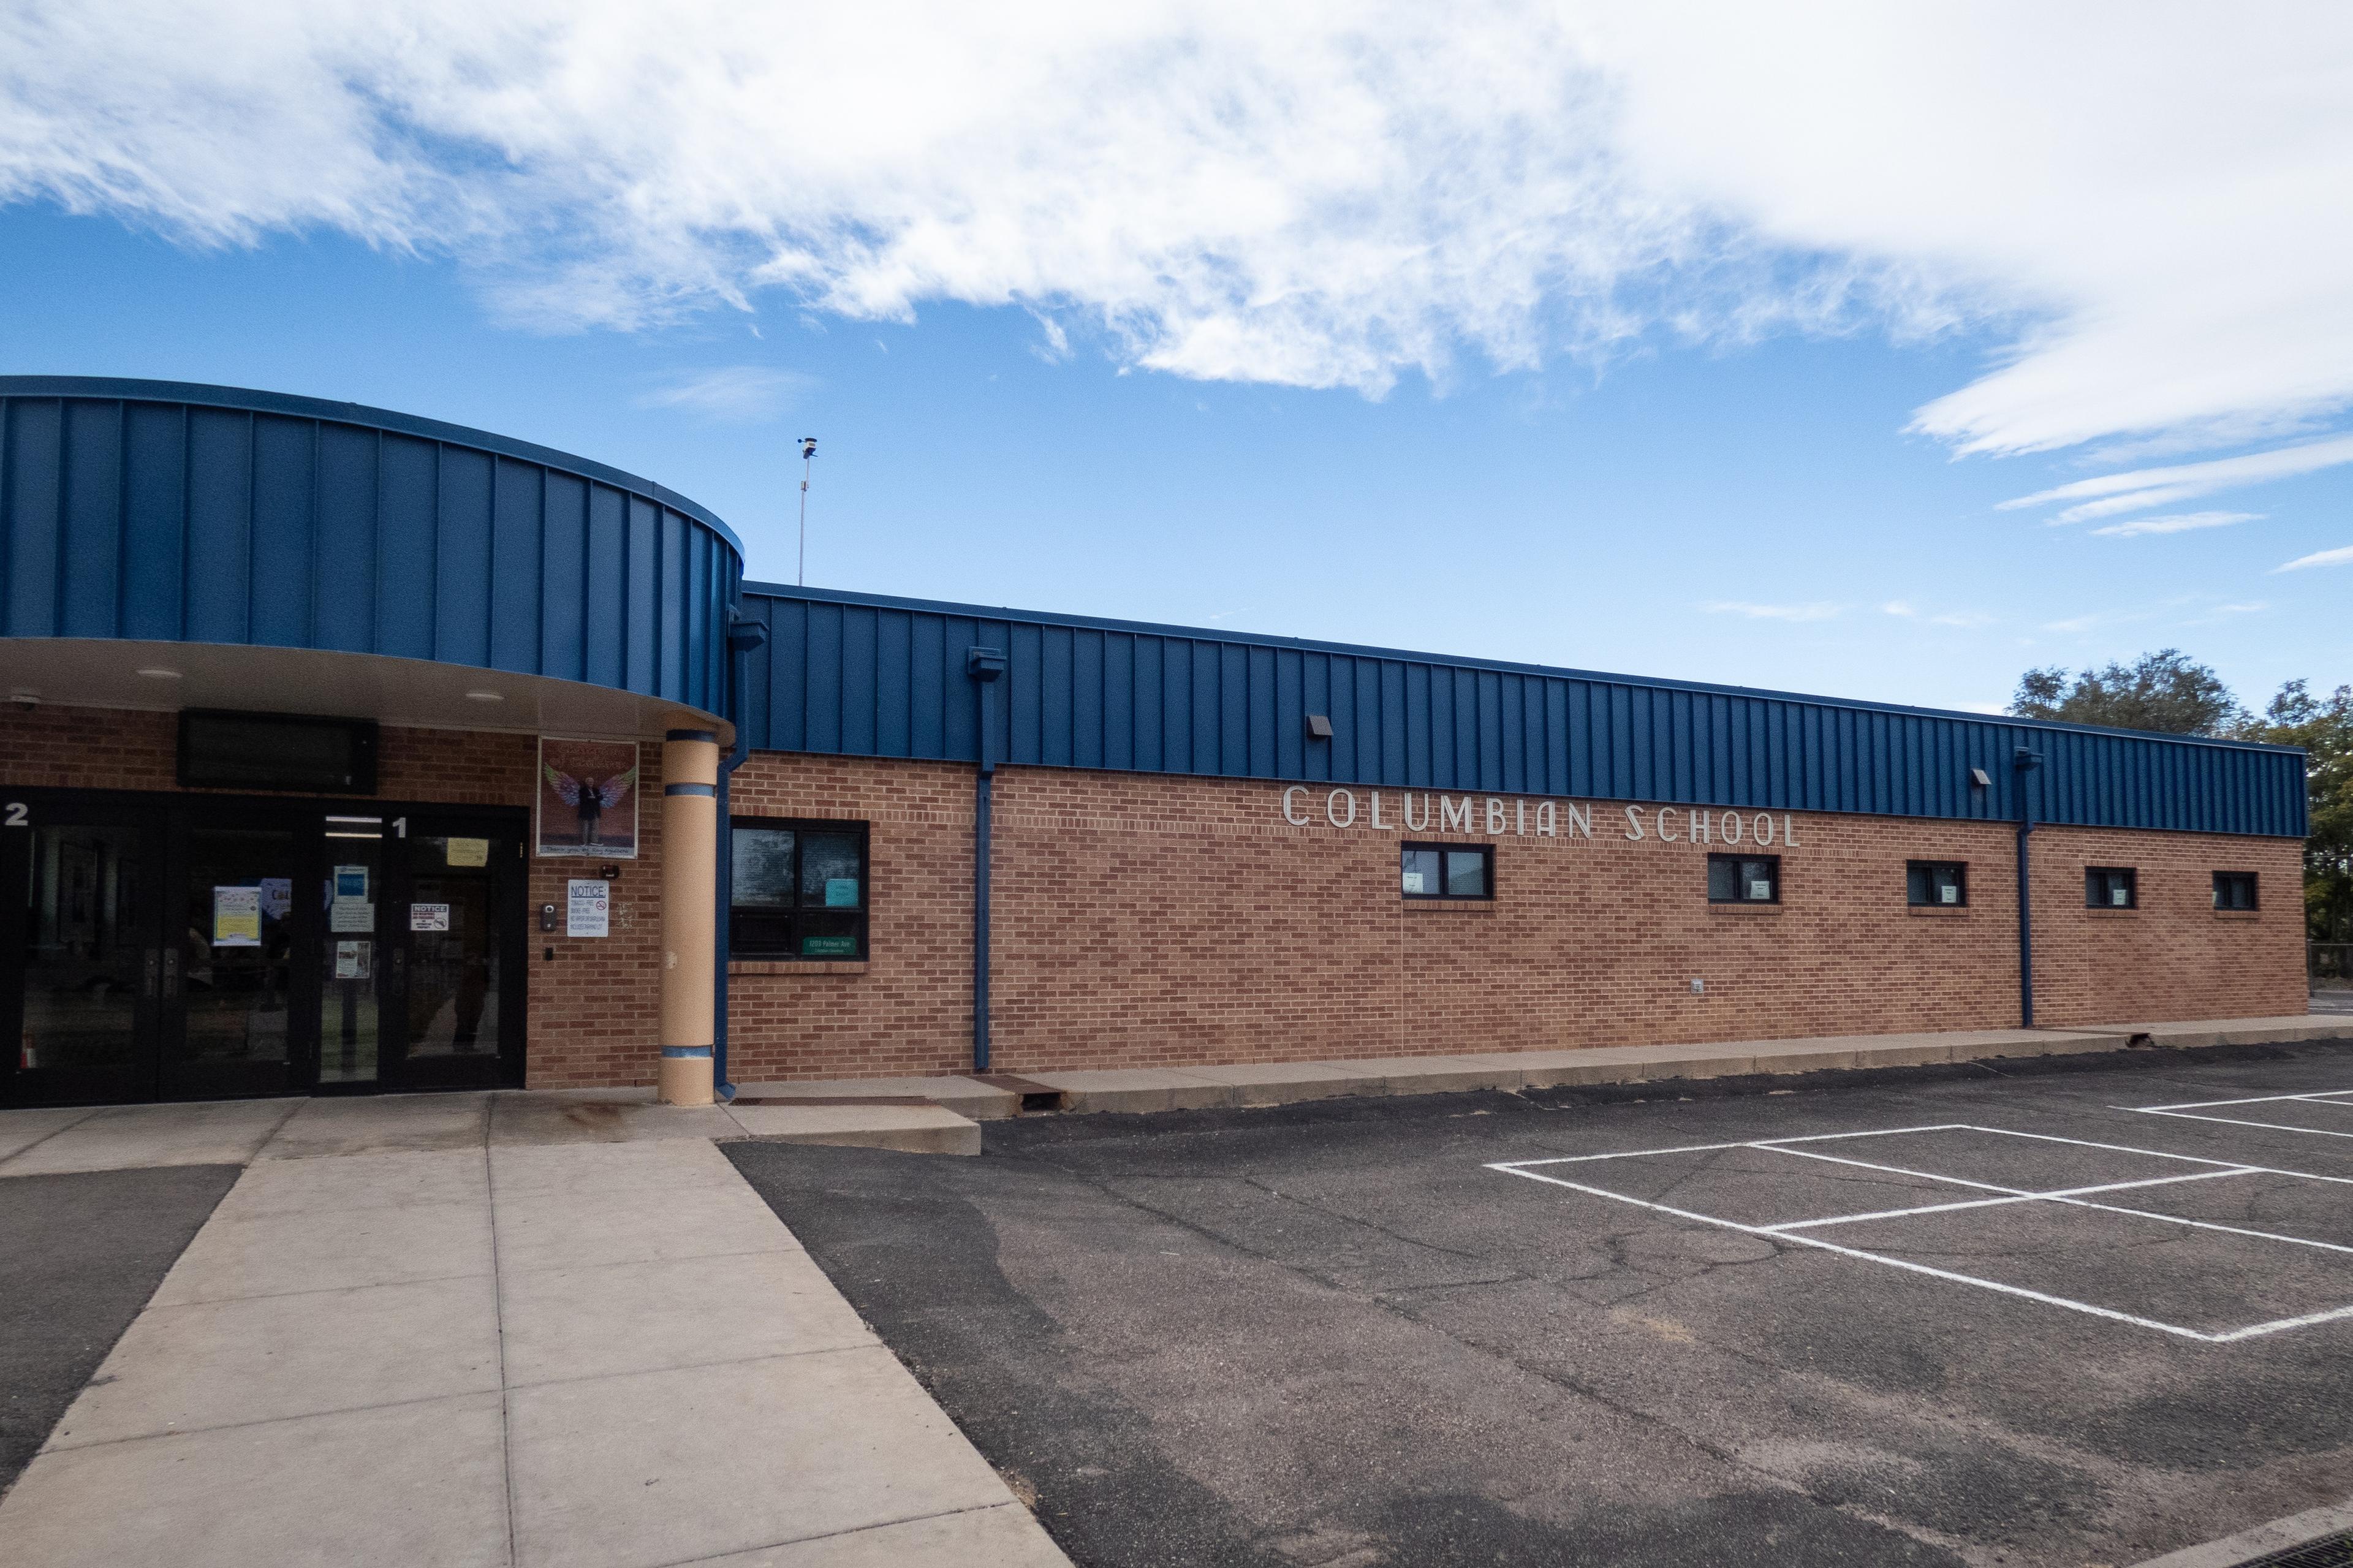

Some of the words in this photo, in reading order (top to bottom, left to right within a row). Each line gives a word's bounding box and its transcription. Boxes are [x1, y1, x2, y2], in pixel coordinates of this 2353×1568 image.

[6, 803, 28, 826] 2
[1283, 785, 1591, 839] COLUMBIAN
[1624, 805, 1800, 847] SCHOOL
[393, 817, 406, 838] 1
